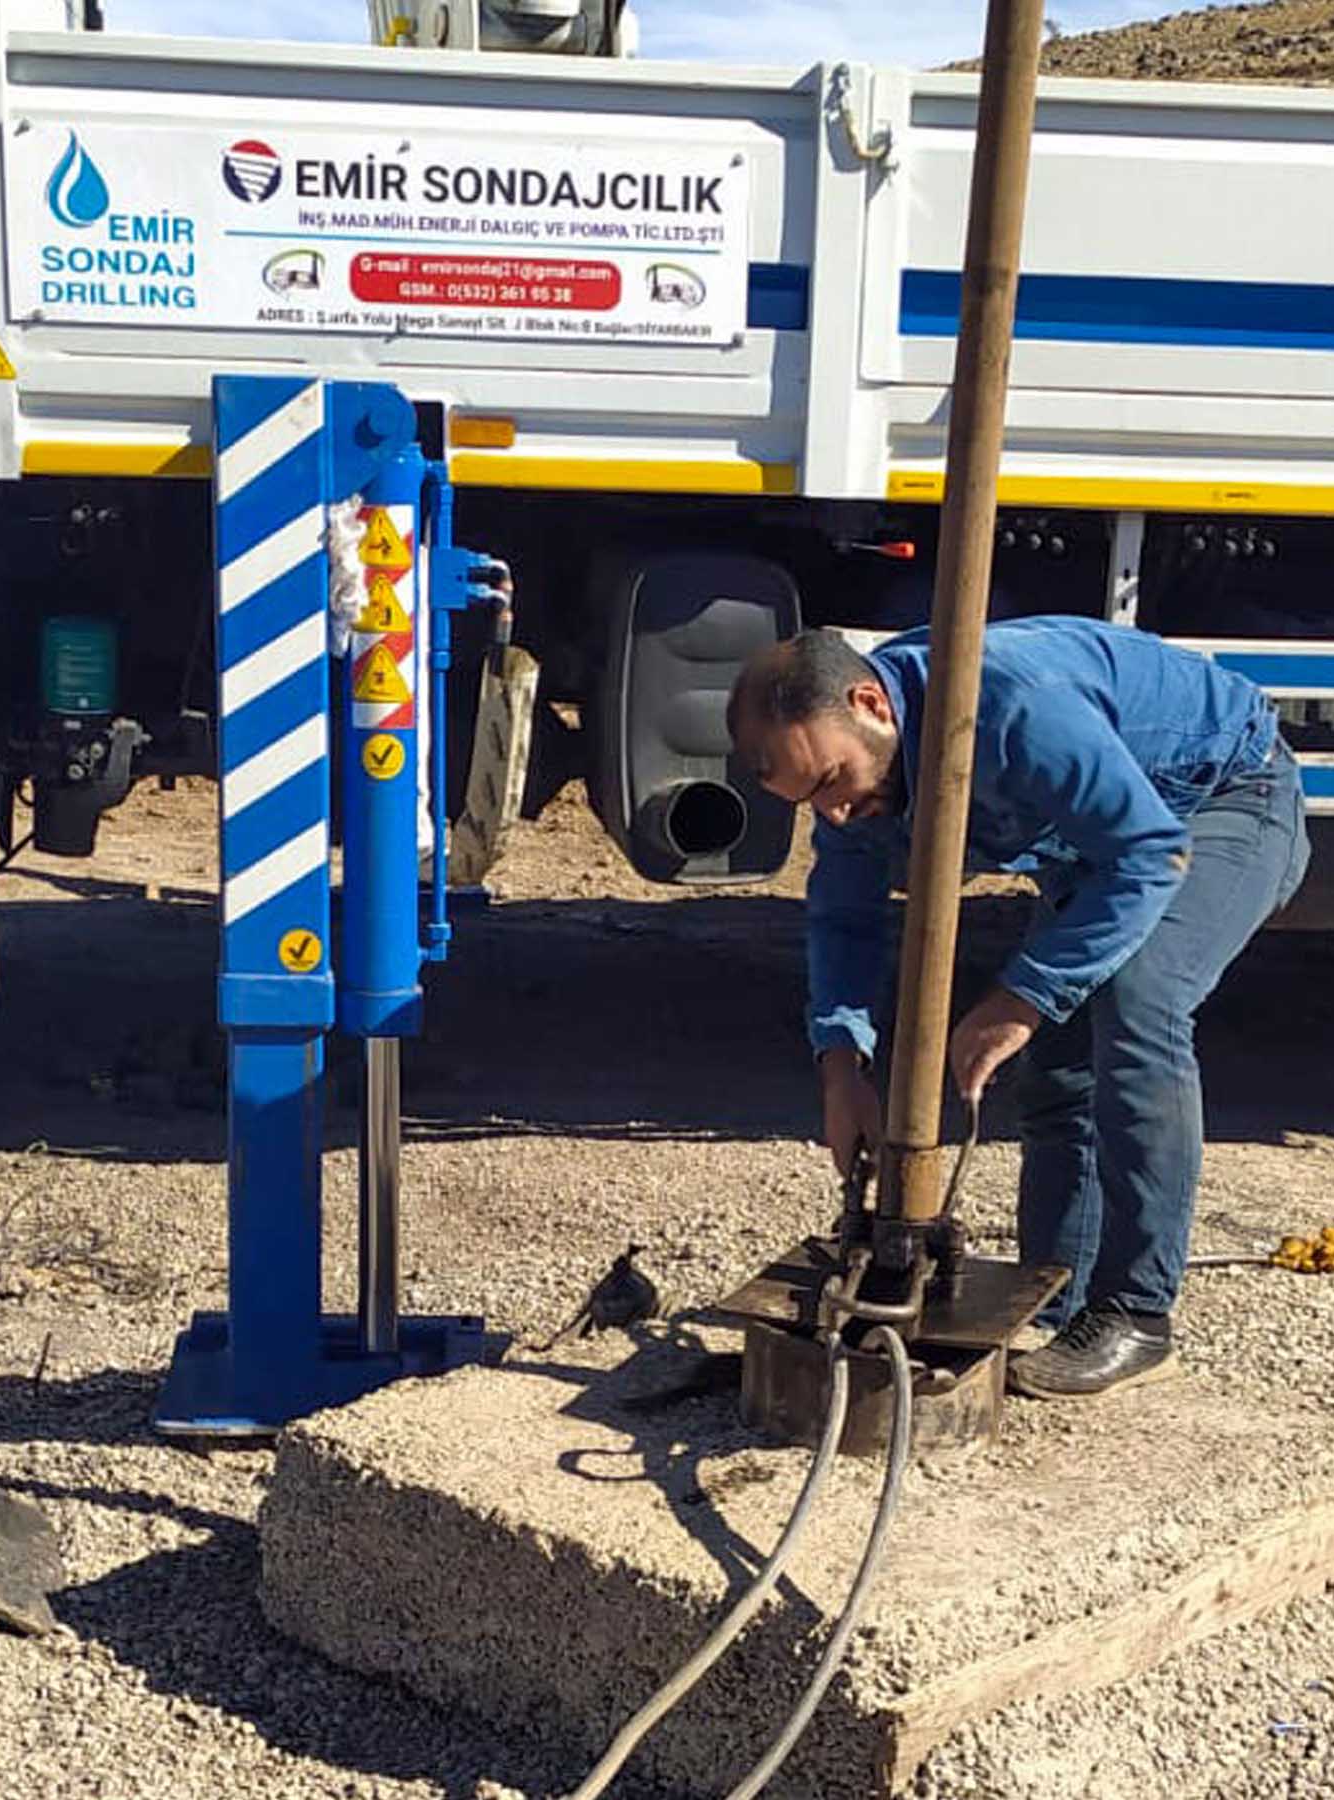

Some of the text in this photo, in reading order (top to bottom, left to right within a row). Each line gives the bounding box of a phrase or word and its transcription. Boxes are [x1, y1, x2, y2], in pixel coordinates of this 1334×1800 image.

[295, 153, 723, 215] EMİR SONDAJCILIK
[109, 208, 195, 244] EMİR
[545, 221, 567, 237] VE
[569, 221, 630, 240] POMPA
[42, 245, 195, 277] SONDAJ
[42, 280, 196, 309] DRILLING
[256, 307, 305, 323] ADRES
[362, 312, 393, 326] Yolu
